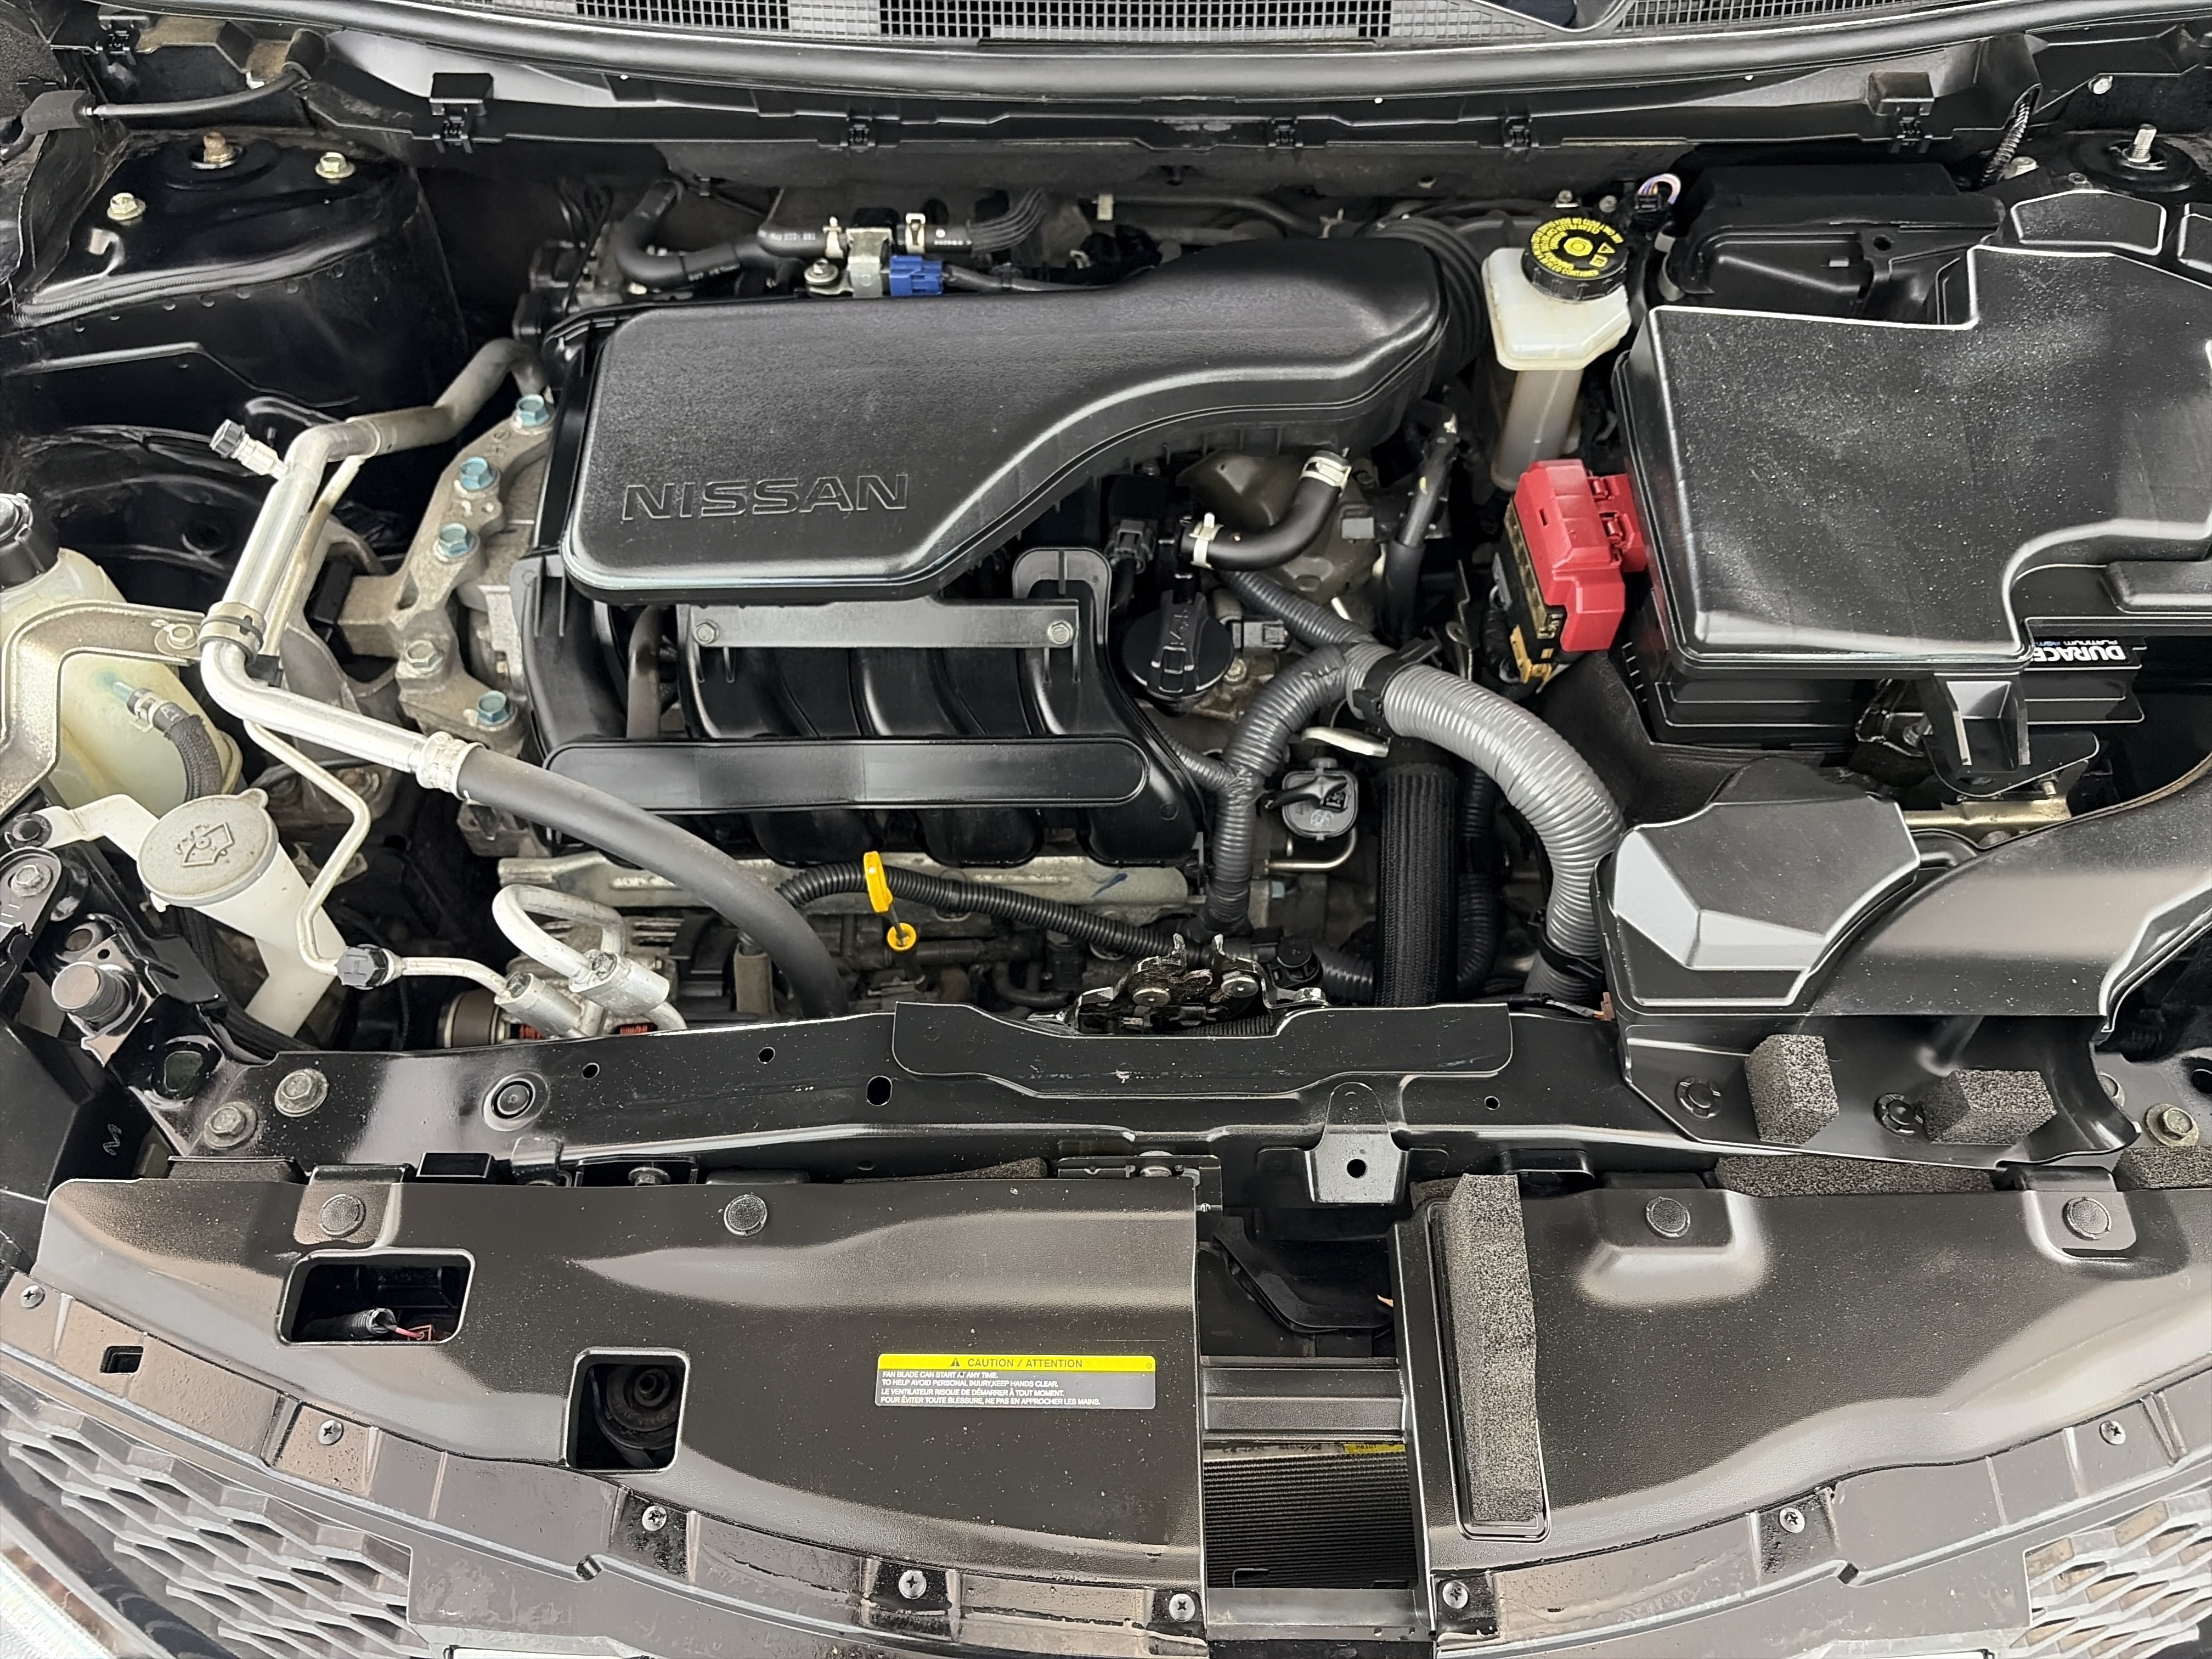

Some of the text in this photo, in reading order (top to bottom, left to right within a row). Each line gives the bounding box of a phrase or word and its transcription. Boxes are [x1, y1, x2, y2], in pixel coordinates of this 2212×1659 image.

[621, 473, 909, 521] NISSAN
[2030, 645, 2126, 662] DURACE
[967, 1358, 1083, 1368] CAUTION / ATTENTION
[972, 1387, 1008, 1396] DÉMARRER
[1009, 1388, 1014, 1396] À
[901, 1395, 924, 1403] ÉVITER
